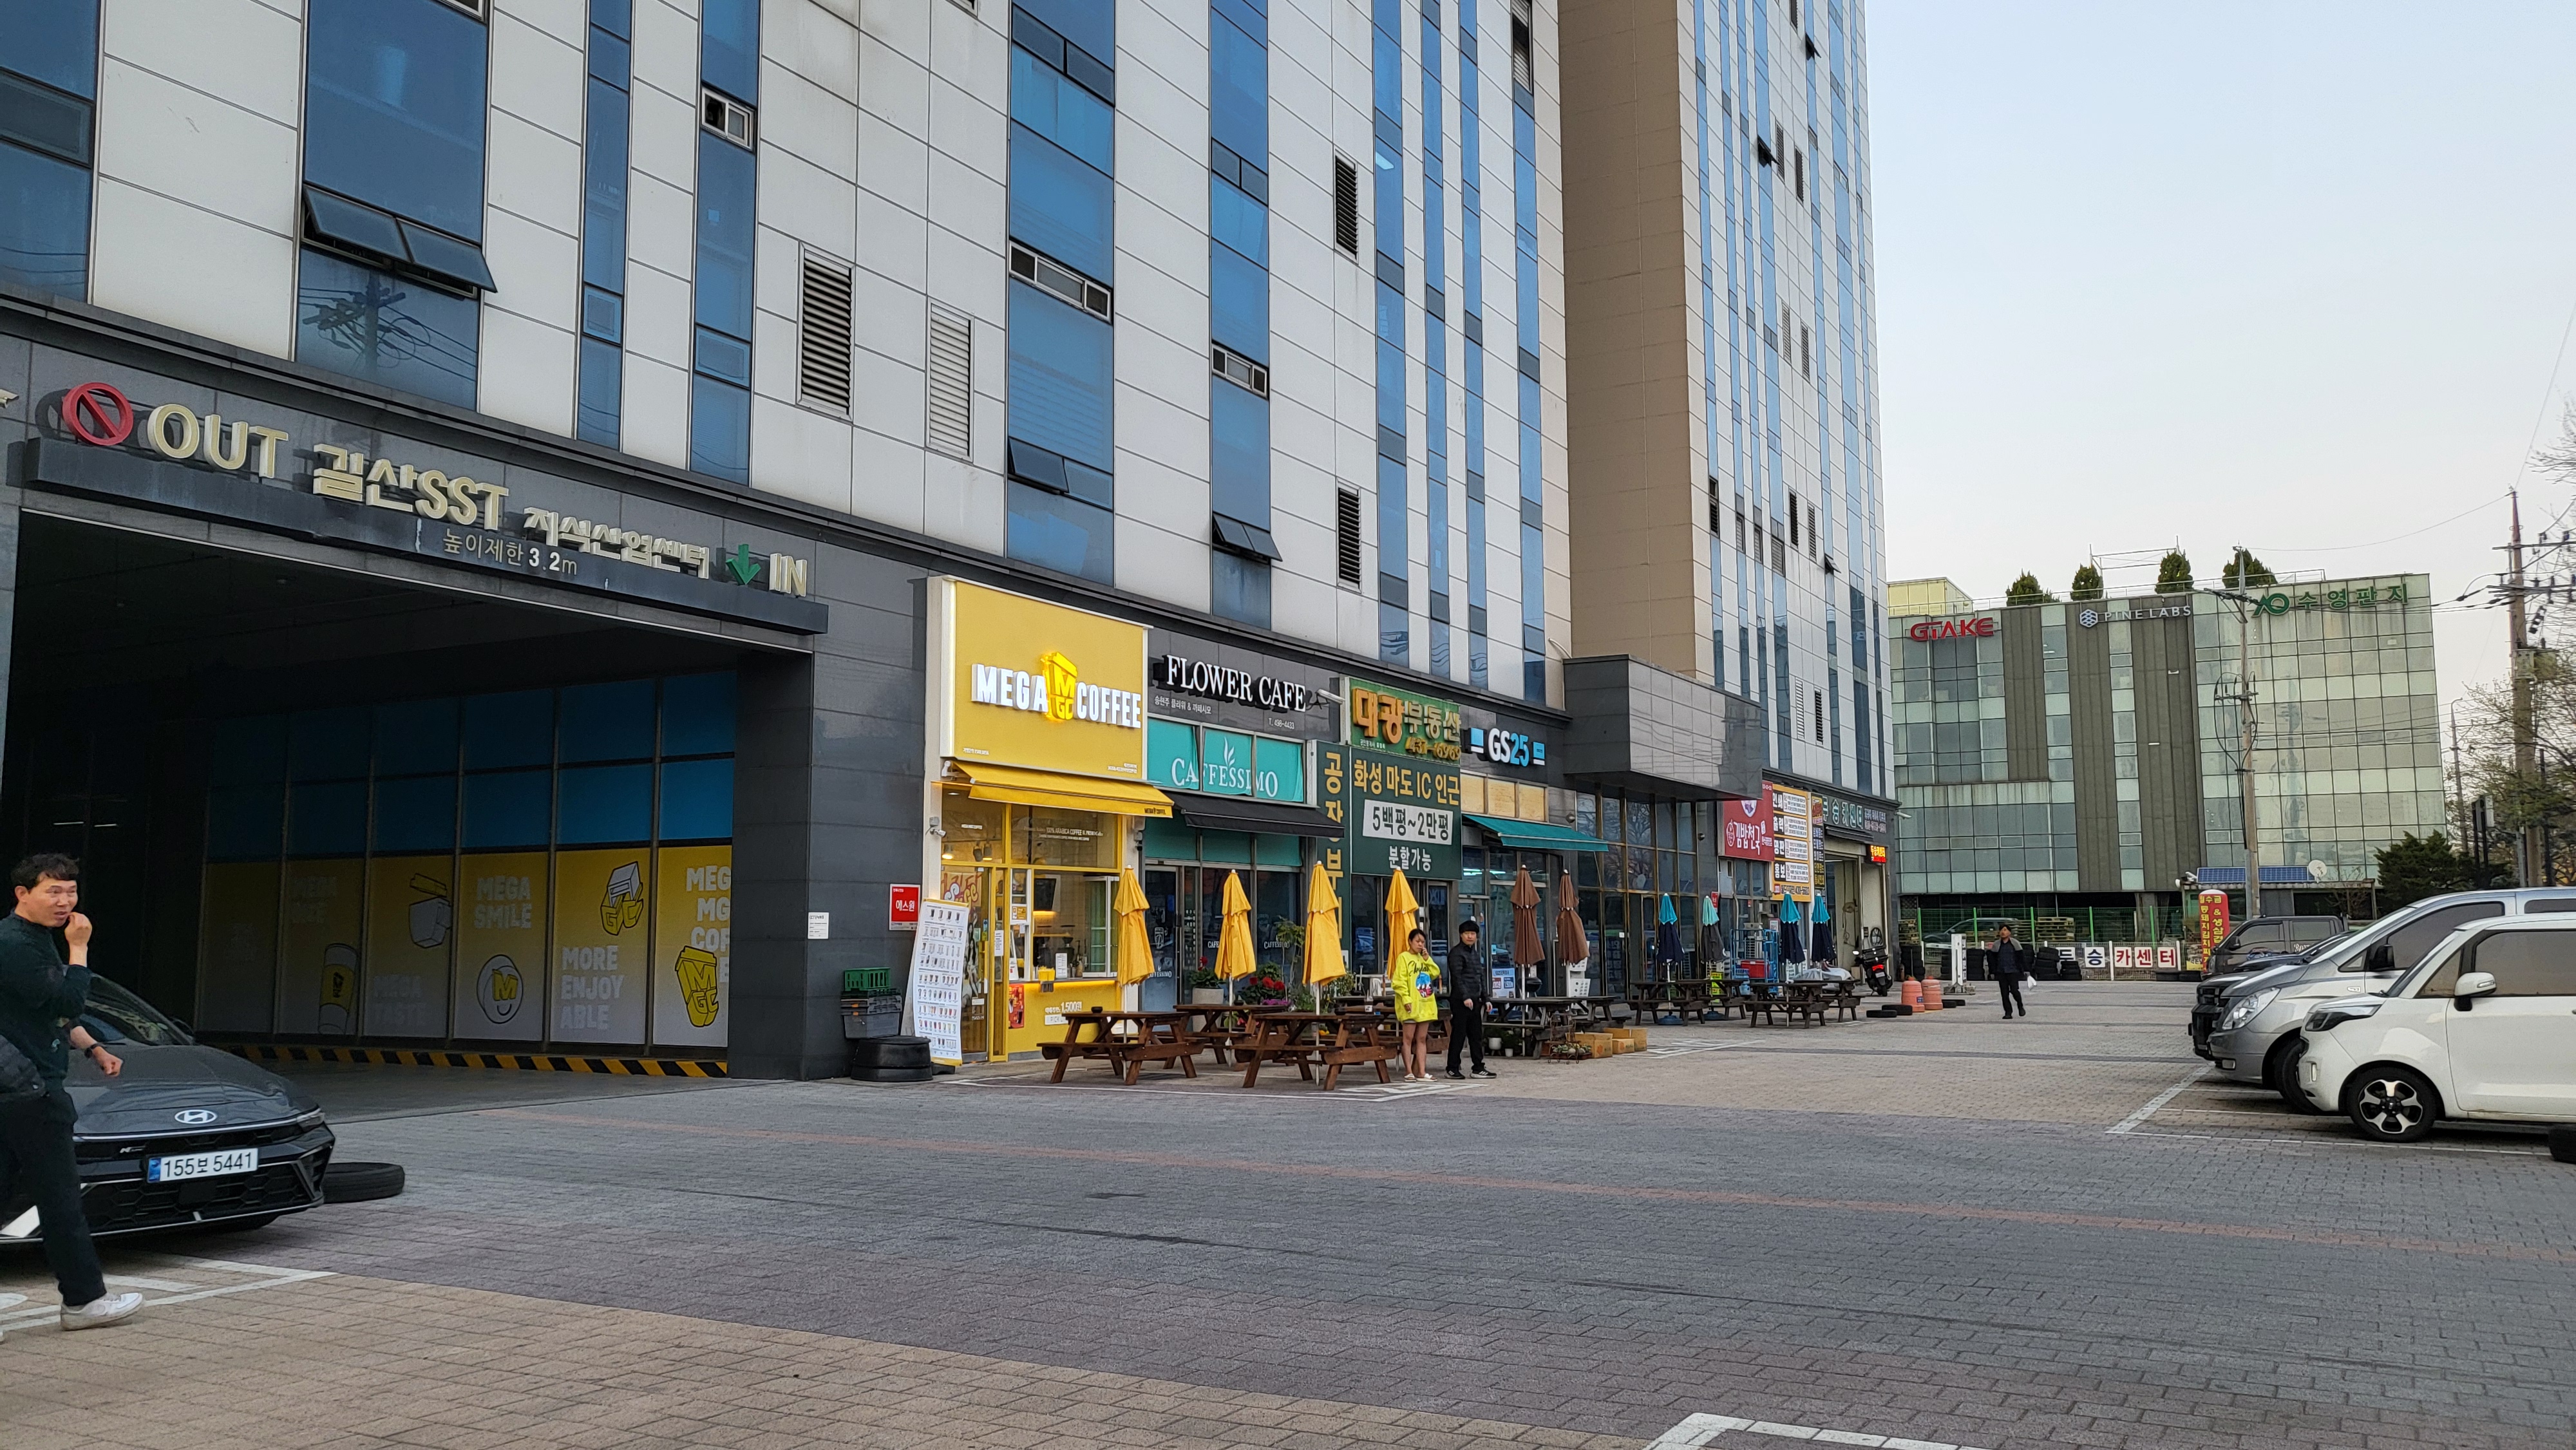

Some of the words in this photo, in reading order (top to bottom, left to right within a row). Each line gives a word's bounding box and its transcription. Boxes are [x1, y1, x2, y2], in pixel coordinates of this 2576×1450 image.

[147, 404, 288, 478] OUT
[443, 528, 524, 566] 높이제한
[529, 548, 578, 576] 3.2m
[524, 507, 709, 579] 지식산업센터
[770, 552, 808, 597] IN
[2298, 583, 2409, 613] 수영판지
[2104, 609, 2143, 622] PINE
[2149, 605, 2191, 619] LABS
[971, 663, 1048, 713] MEGA
[1074, 681, 1141, 729] COFFEE
[1167, 654, 1253, 702] FLOWER
[1258, 675, 1306, 712] CAFE
[1405, 736, 1462, 761] 431-6969
[1488, 728, 1530, 767] GS25
[1354, 759, 1383, 795] 화성
[1386, 765, 1414, 797] 마도
[1416, 771, 1432, 799] IC
[1435, 774, 1460, 806] 인근
[1733, 821, 1761, 856] 김밥천국
[1388, 845, 1432, 872] 분할가능
[477, 876, 531, 901] MEGA
[473, 903, 532, 929] SMILE
[895, 899, 915, 912] 에스원
[562, 945, 618, 970] MORE
[560, 975, 625, 1000] ENJOY
[560, 1004, 610, 1030] ABLE
[213, 1151, 252, 1172] 5441
